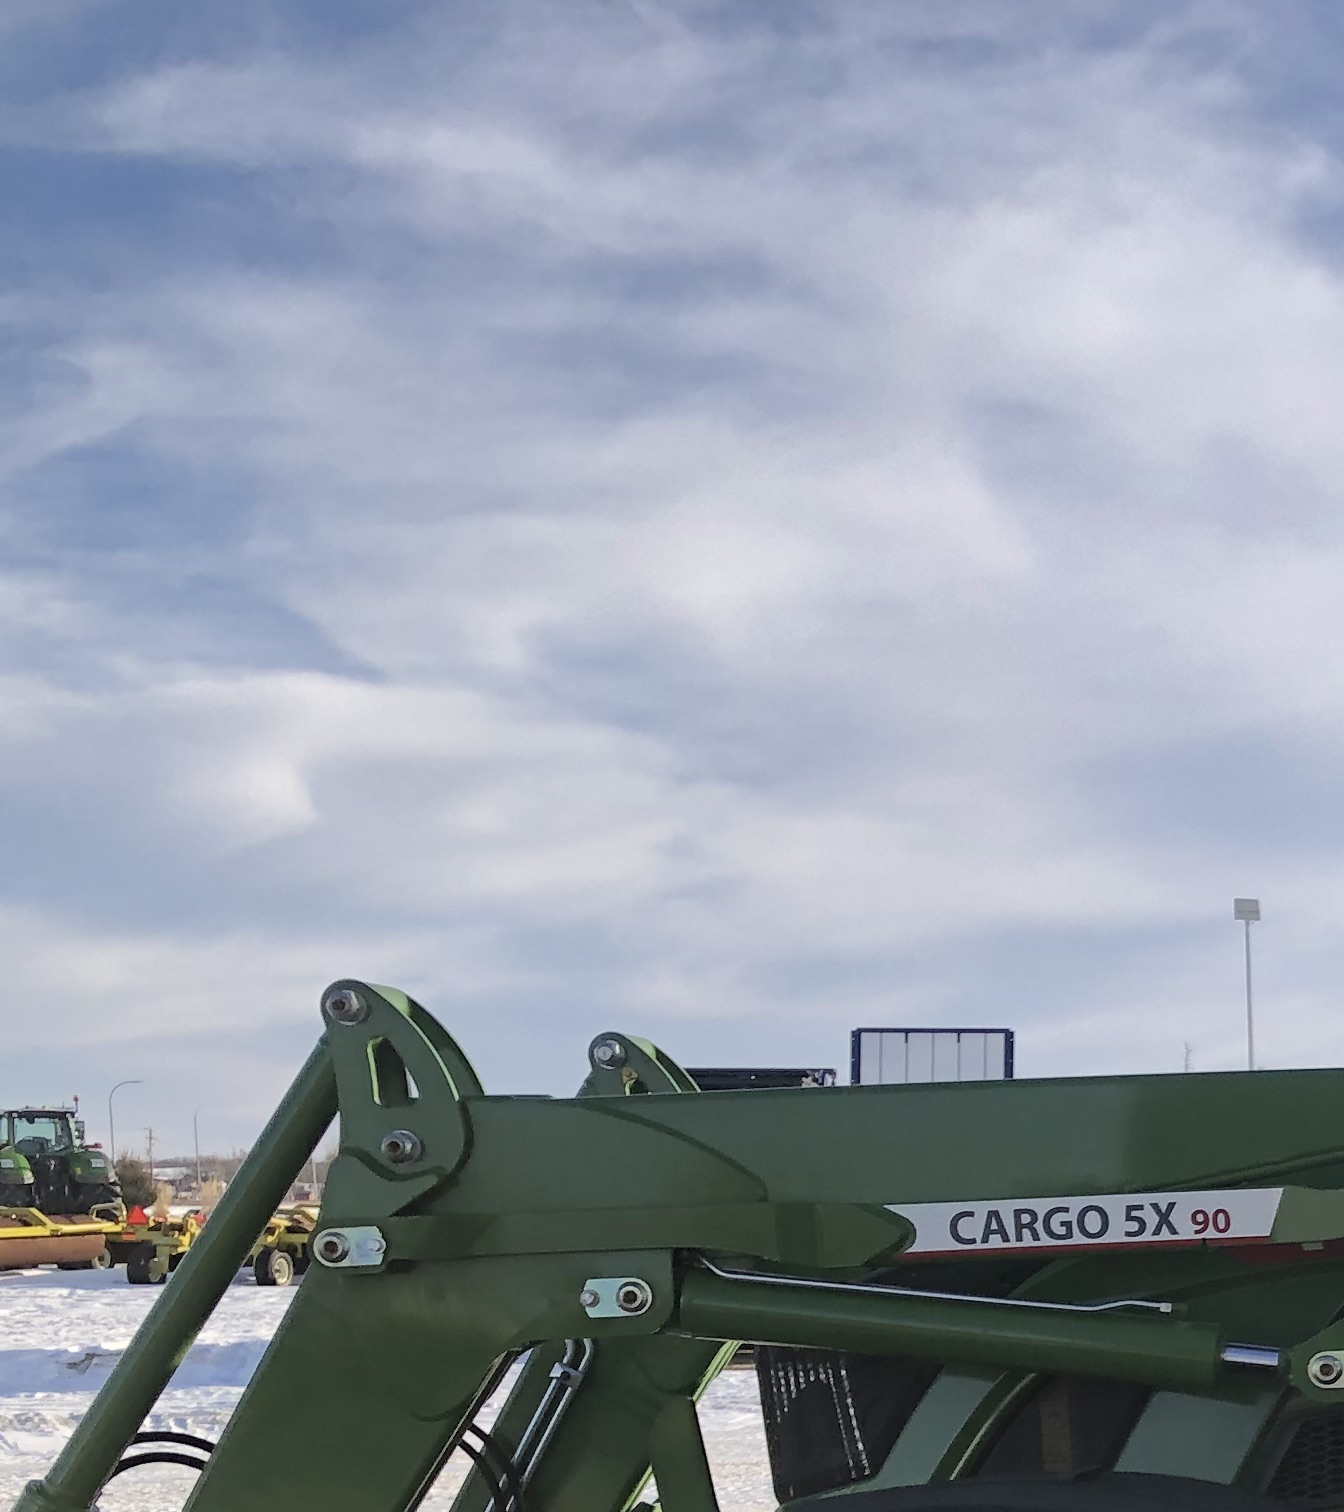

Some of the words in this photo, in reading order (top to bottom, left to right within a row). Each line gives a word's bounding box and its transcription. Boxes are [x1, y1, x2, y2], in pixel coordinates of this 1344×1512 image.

[948, 1203, 1109, 1244] CARGO
[1122, 1201, 1181, 1239] 5X
[1190, 1208, 1232, 1237] 90
